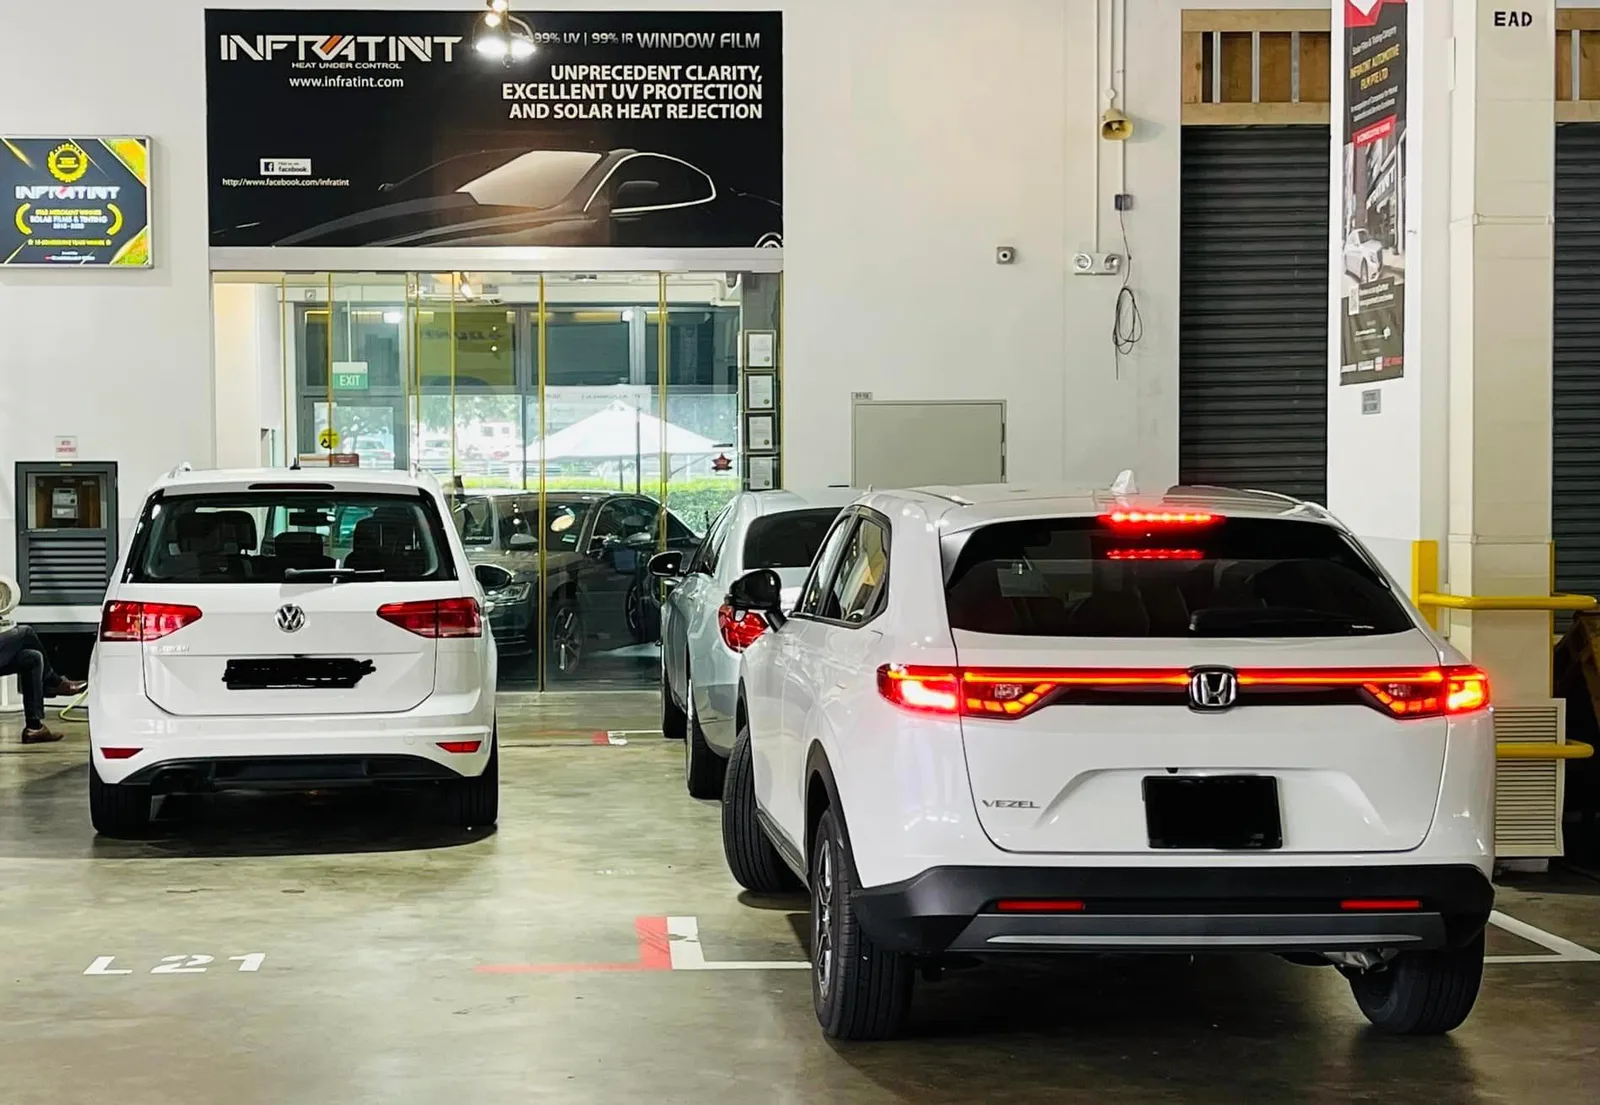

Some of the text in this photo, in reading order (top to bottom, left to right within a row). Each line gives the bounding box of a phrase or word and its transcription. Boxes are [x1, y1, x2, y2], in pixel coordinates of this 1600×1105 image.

[1494, 11, 1533, 27] EAD
[220, 34, 463, 62] INFRATINT
[563, 32, 581, 44] UV
[591, 32, 619, 44] 99%
[621, 32, 634, 44] IR
[636, 32, 716, 49] WINDOW
[720, 32, 761, 49] FILM
[355, 62, 402, 70] CONTROL
[550, 65, 763, 83] UNPRECEDENT CLARITY,
[289, 75, 404, 88] www.infratint.com
[502, 84, 763, 100] EXCELLENT UV PROTECTION
[509, 103, 763, 119] AND SOLAR HEAT REJECTION
[222, 178, 350, 187] http://www.facebook.com/infratint
[340, 375, 360, 386] EXIT
[982, 800, 1041, 809] VEZEL
